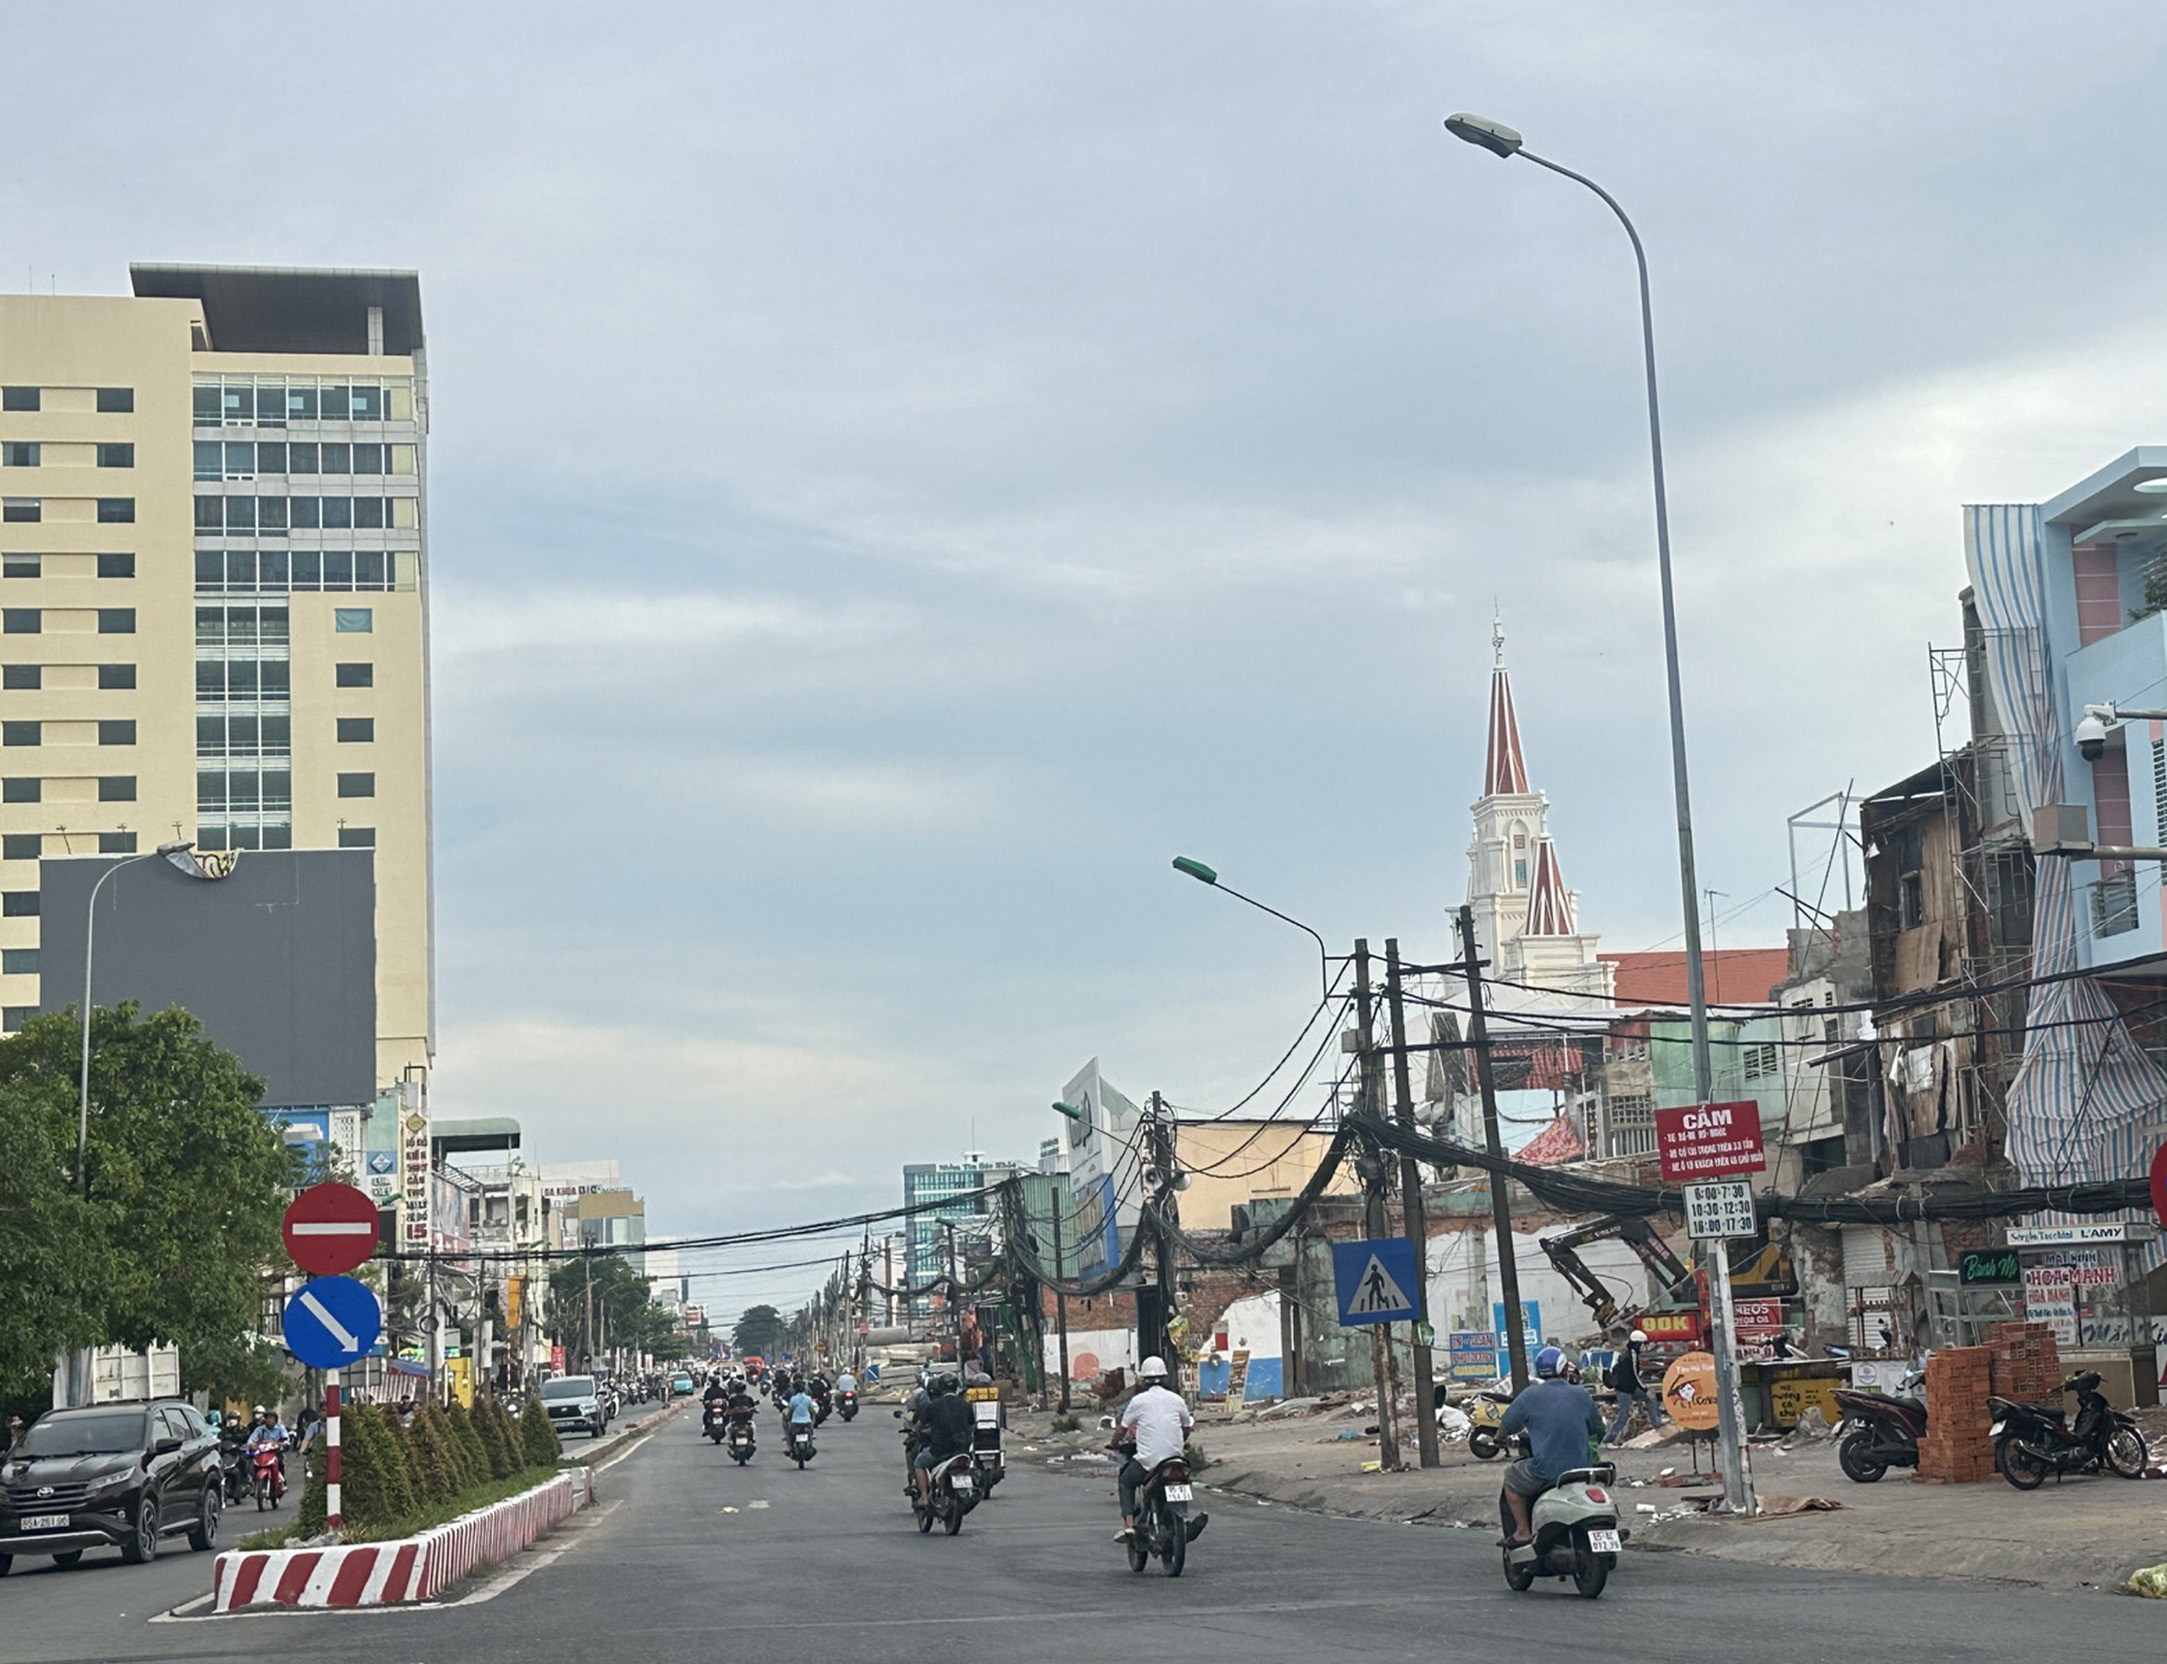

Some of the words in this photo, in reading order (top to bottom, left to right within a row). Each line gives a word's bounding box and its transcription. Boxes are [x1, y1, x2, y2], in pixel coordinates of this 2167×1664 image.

[1682, 1105, 1733, 1130] CẤM
[406, 1223, 427, 1240] 15
[2081, 1227, 2122, 1239] L'AMY
[1734, 1303, 1770, 1315] NEOS
[1641, 1315, 1689, 1332] 90K
[1734, 1316, 1755, 1325] OTOR
